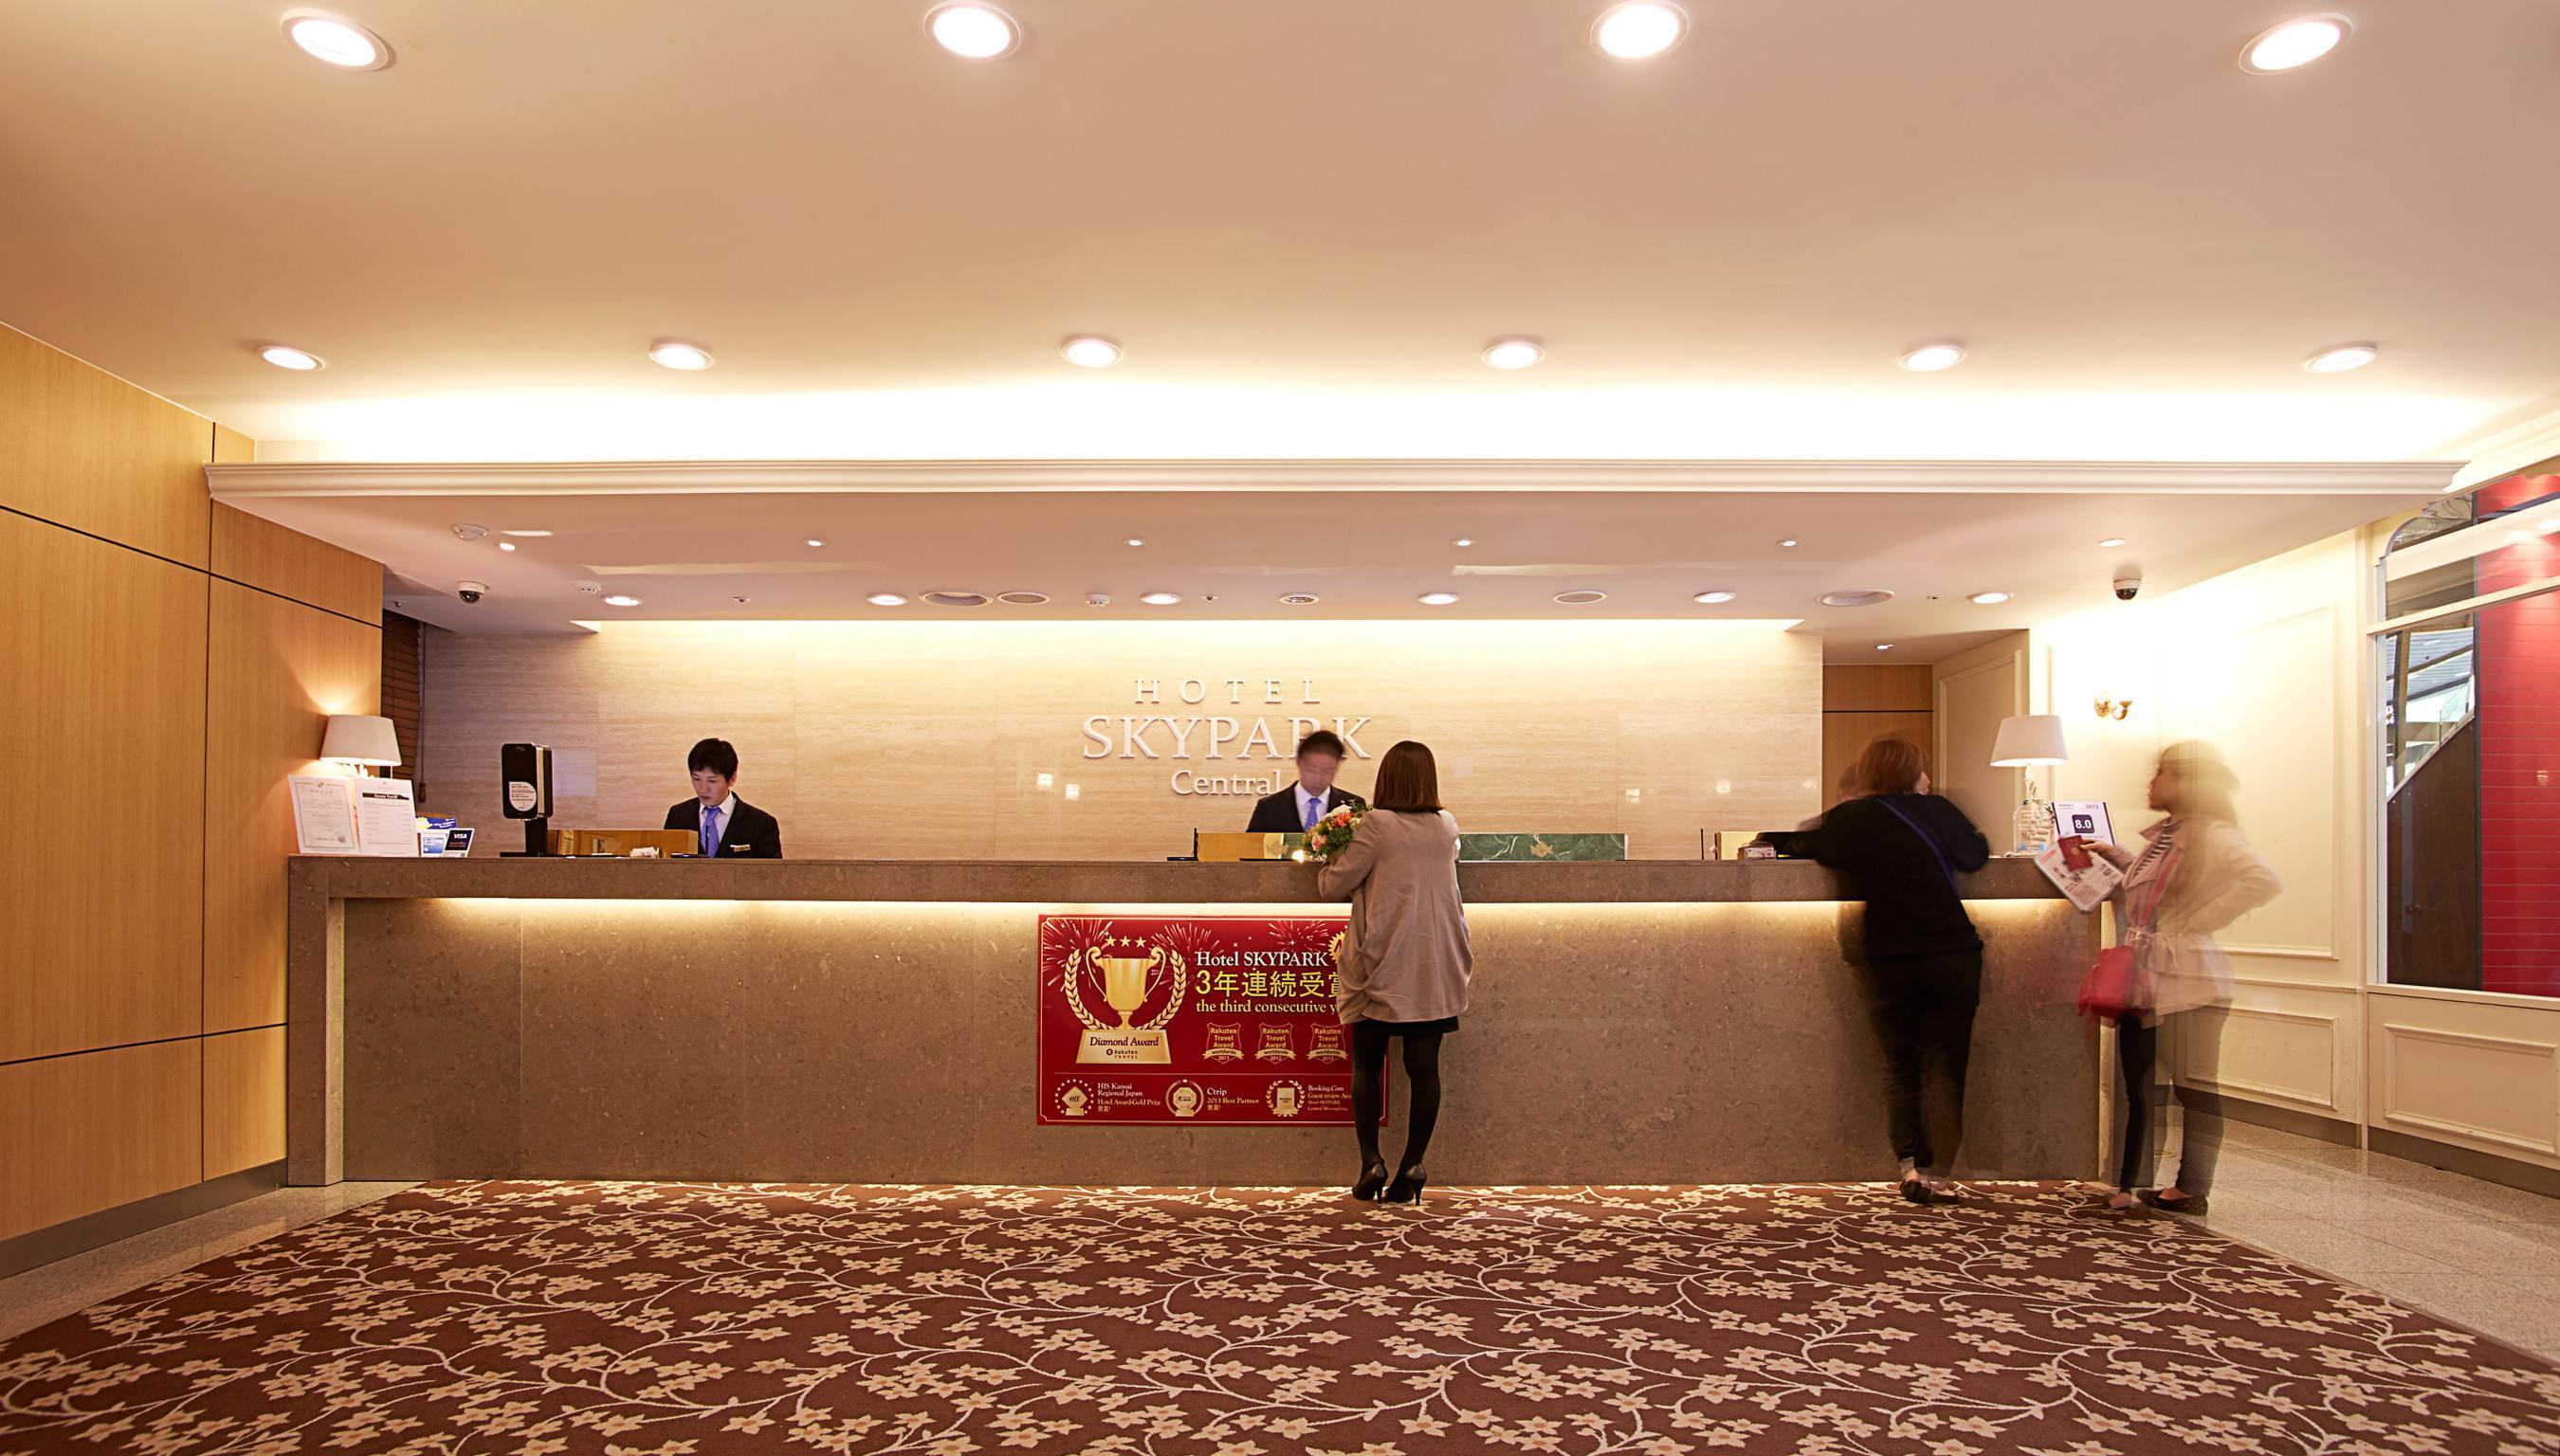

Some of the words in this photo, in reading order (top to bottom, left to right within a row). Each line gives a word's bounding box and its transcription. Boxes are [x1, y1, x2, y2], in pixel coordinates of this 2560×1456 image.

[1134, 678, 1322, 703] HOTEL
[1082, 716, 1372, 759] SKYPARK
[1170, 769, 1282, 796] Central
[2075, 819, 2092, 829] 8.0
[1195, 951, 1239, 966] Hotel
[1243, 951, 1329, 966] SKYPARK
[1196, 999, 1216, 1012] the
[1220, 999, 1251, 1012] third
[1254, 1000, 1326, 1012] consecutive
[1089, 1037, 1129, 1046] Diamond
[1130, 1037, 1159, 1046] Award
[1207, 1087, 1227, 1096] Ctrip
